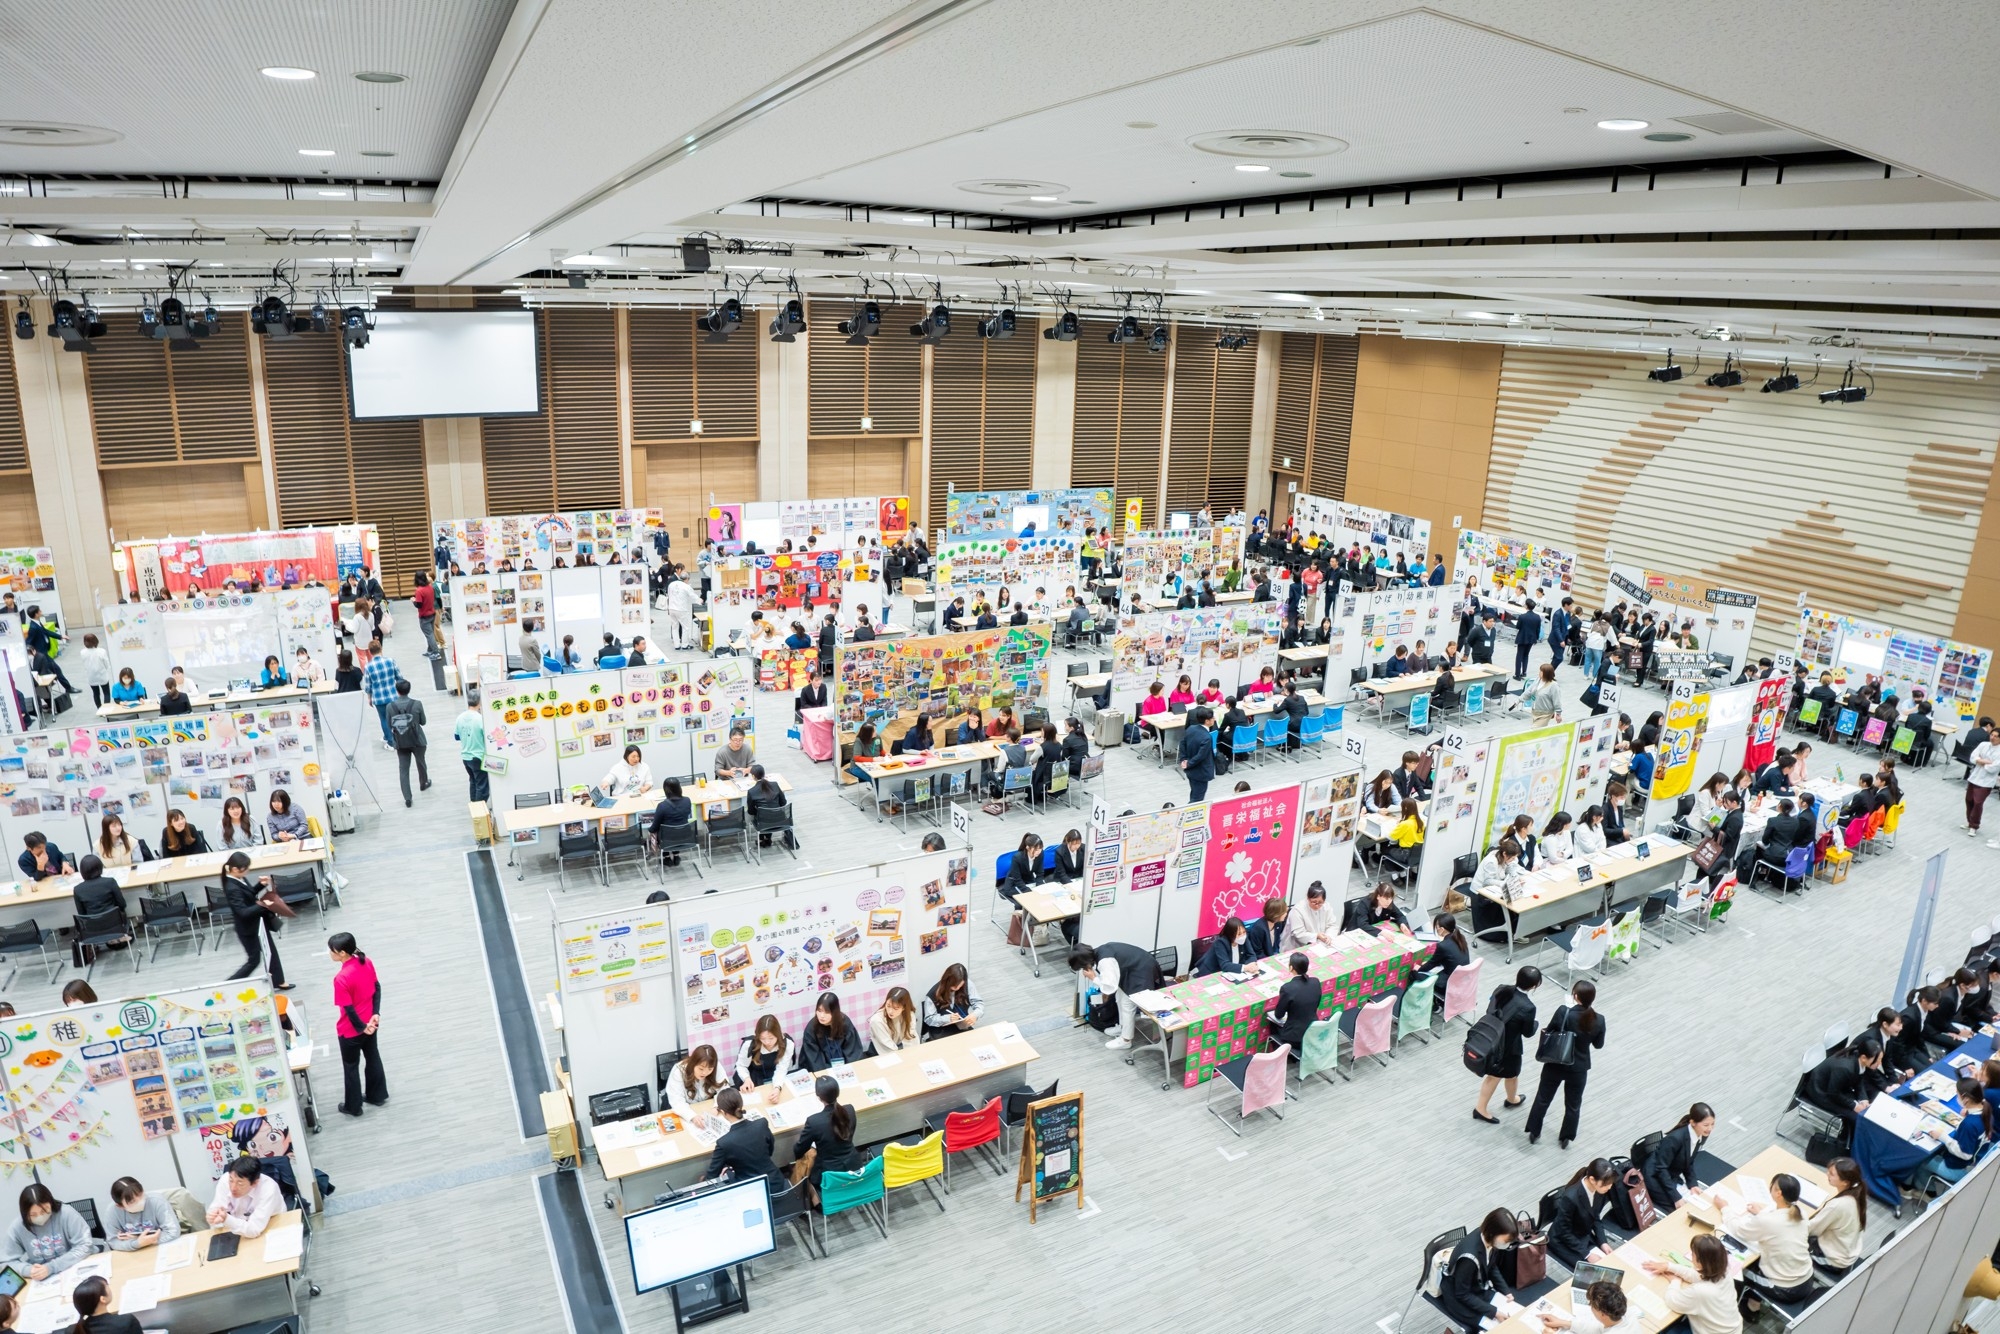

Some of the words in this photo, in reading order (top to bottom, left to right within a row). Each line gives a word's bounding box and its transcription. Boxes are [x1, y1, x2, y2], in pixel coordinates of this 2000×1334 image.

[1455, 569, 1465, 579] 39
[1272, 584, 1282, 594] 38
[1341, 584, 1350, 595] 47
[1374, 591, 1435, 604] ひばり幼稚園
[1041, 604, 1050, 616] 37
[1121, 604, 1130, 615] 46
[1778, 655, 1792, 666] 55
[612, 684, 707, 707] ひじり幼稚
[1603, 689, 1616, 703] 54
[1676, 685, 1690, 698] 63
[505, 699, 606, 723] 認定こども園
[662, 699, 710, 717] 保育園
[98, 727, 130, 739] 千里山
[136, 724, 168, 736] グレース
[173, 720, 205, 732] 幼稚園
[1346, 738, 1361, 756] 53
[1447, 734, 1462, 750] 62
[1241, 798, 1273, 808] 社会福祉法人
[1094, 805, 1106, 825] 61
[1222, 803, 1287, 828] 晋栄福祉会
[954, 811, 966, 833] 52
[1221, 836, 1239, 846] OSAKA
[1243, 831, 1263, 840] HYOGO
